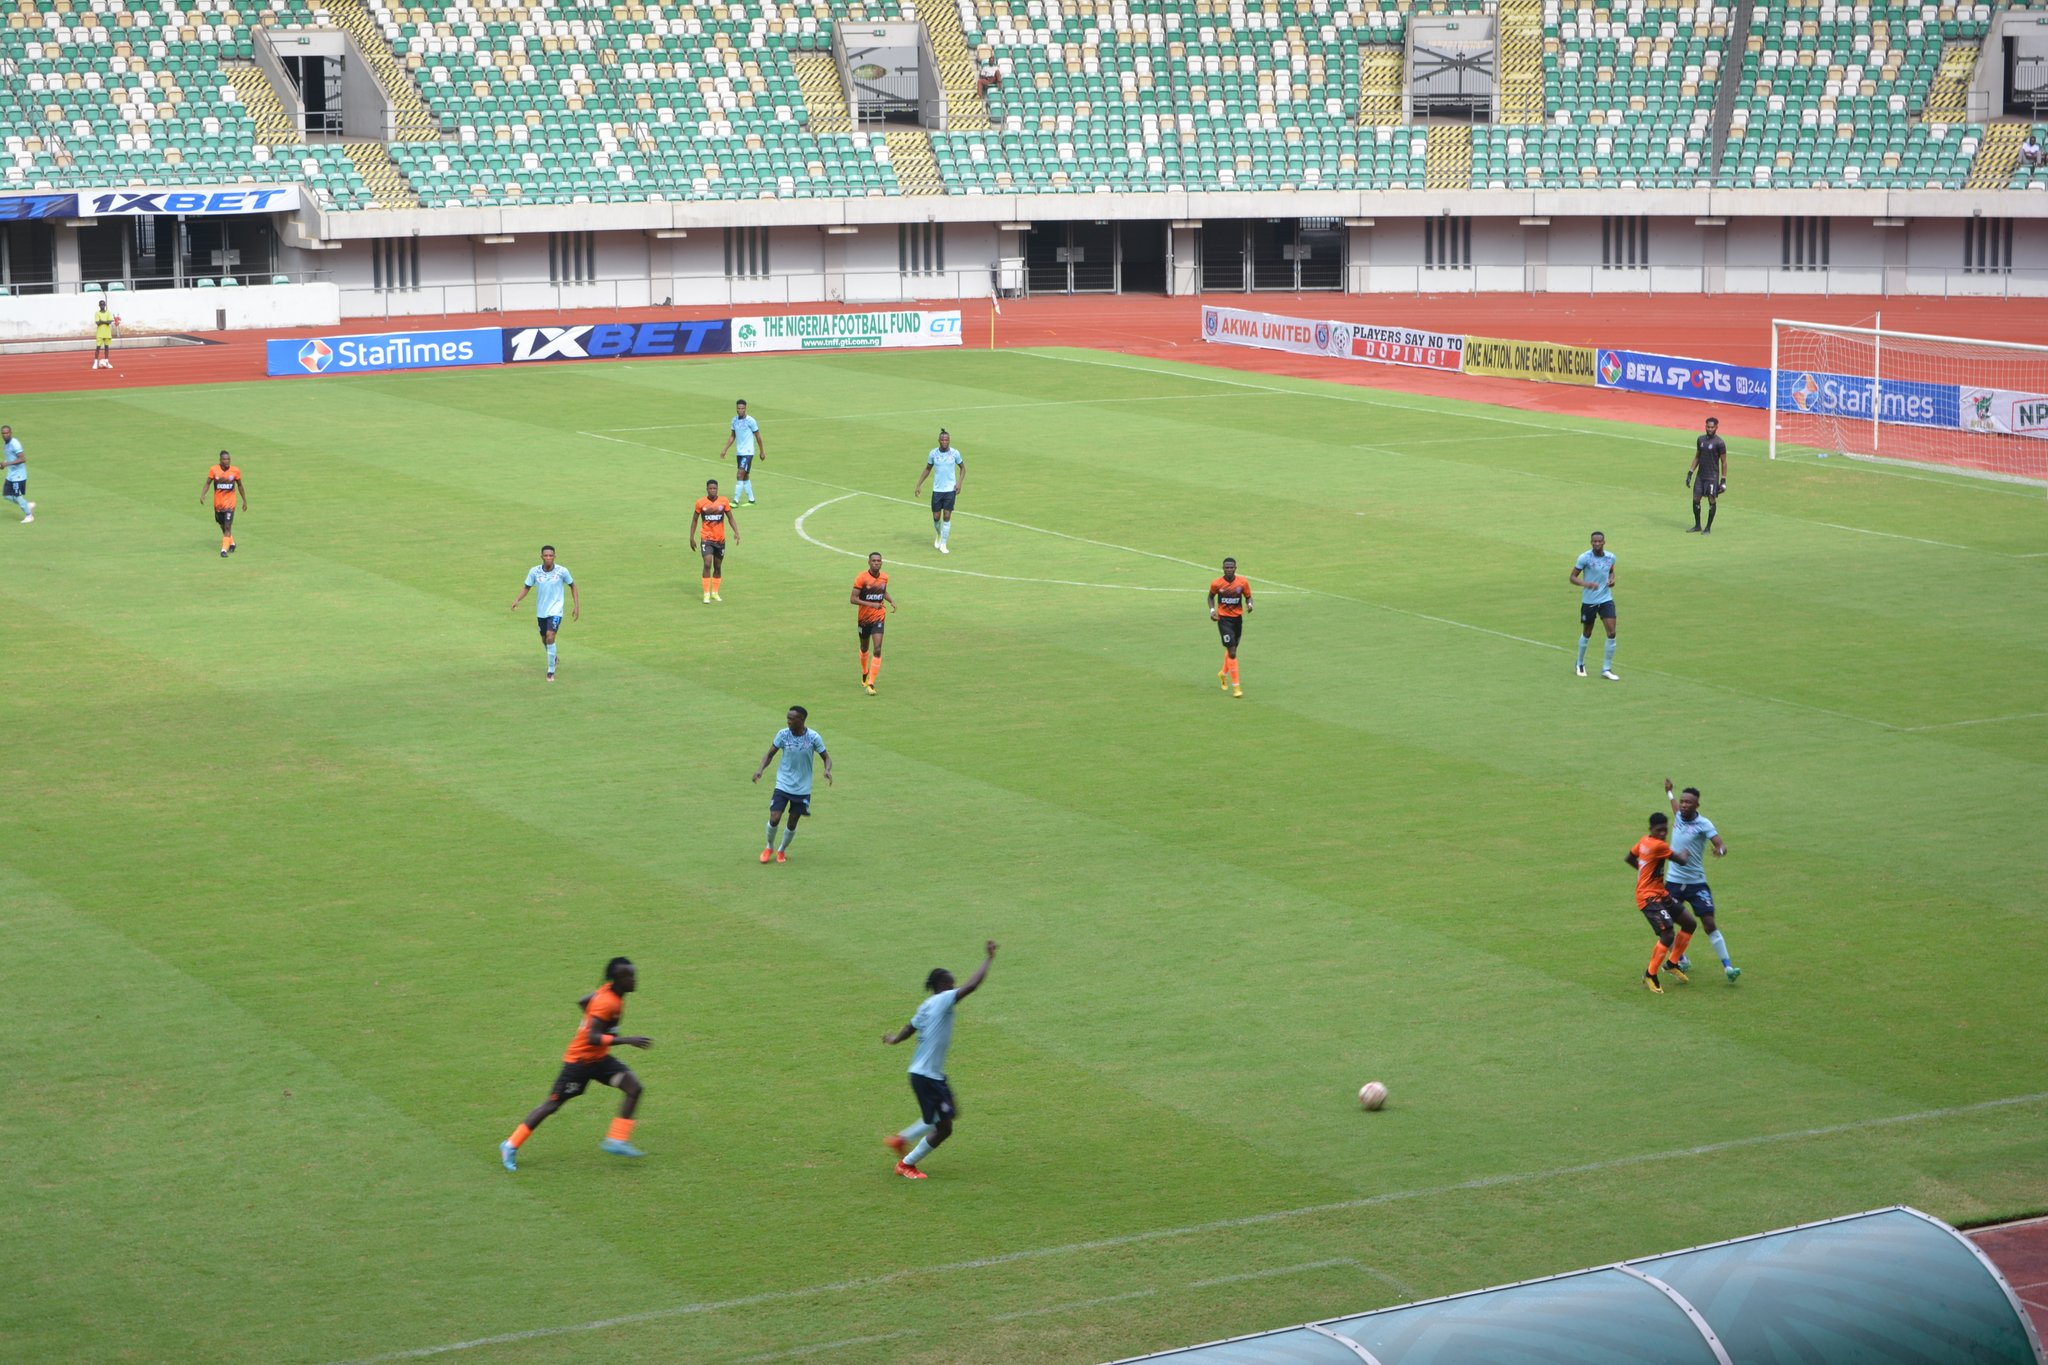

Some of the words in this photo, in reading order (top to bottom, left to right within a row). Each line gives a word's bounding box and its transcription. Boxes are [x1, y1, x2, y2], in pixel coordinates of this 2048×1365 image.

[92, 189, 287, 213] 1XBET
[763, 316, 784, 337] THE
[786, 315, 830, 337] NIGERIA
[832, 313, 888, 335] FOOTBALL
[890, 312, 921, 334] FUND
[1221, 317, 1258, 338] AKWA
[1262, 324, 1312, 344] UNITED
[511, 320, 724, 362] 1XBET
[739, 340, 757, 348] TNFF
[803, 337, 880, 347] www.tnff.gti.com.ng
[1353, 326, 1402, 344] PLAYERS
[1404, 333, 1425, 347] SAY
[1428, 335, 1443, 349] NO
[1447, 338, 1463, 350] TO
[338, 338, 474, 367] StarTimes
[1366, 341, 1446, 366] DOPING!
[1466, 342, 1482, 367] ONE
[1515, 346, 1531, 371] ONE
[1557, 349, 1573, 375] ONE
[1574, 351, 1595, 377] GOAL
[1626, 361, 1664, 385] BETA
